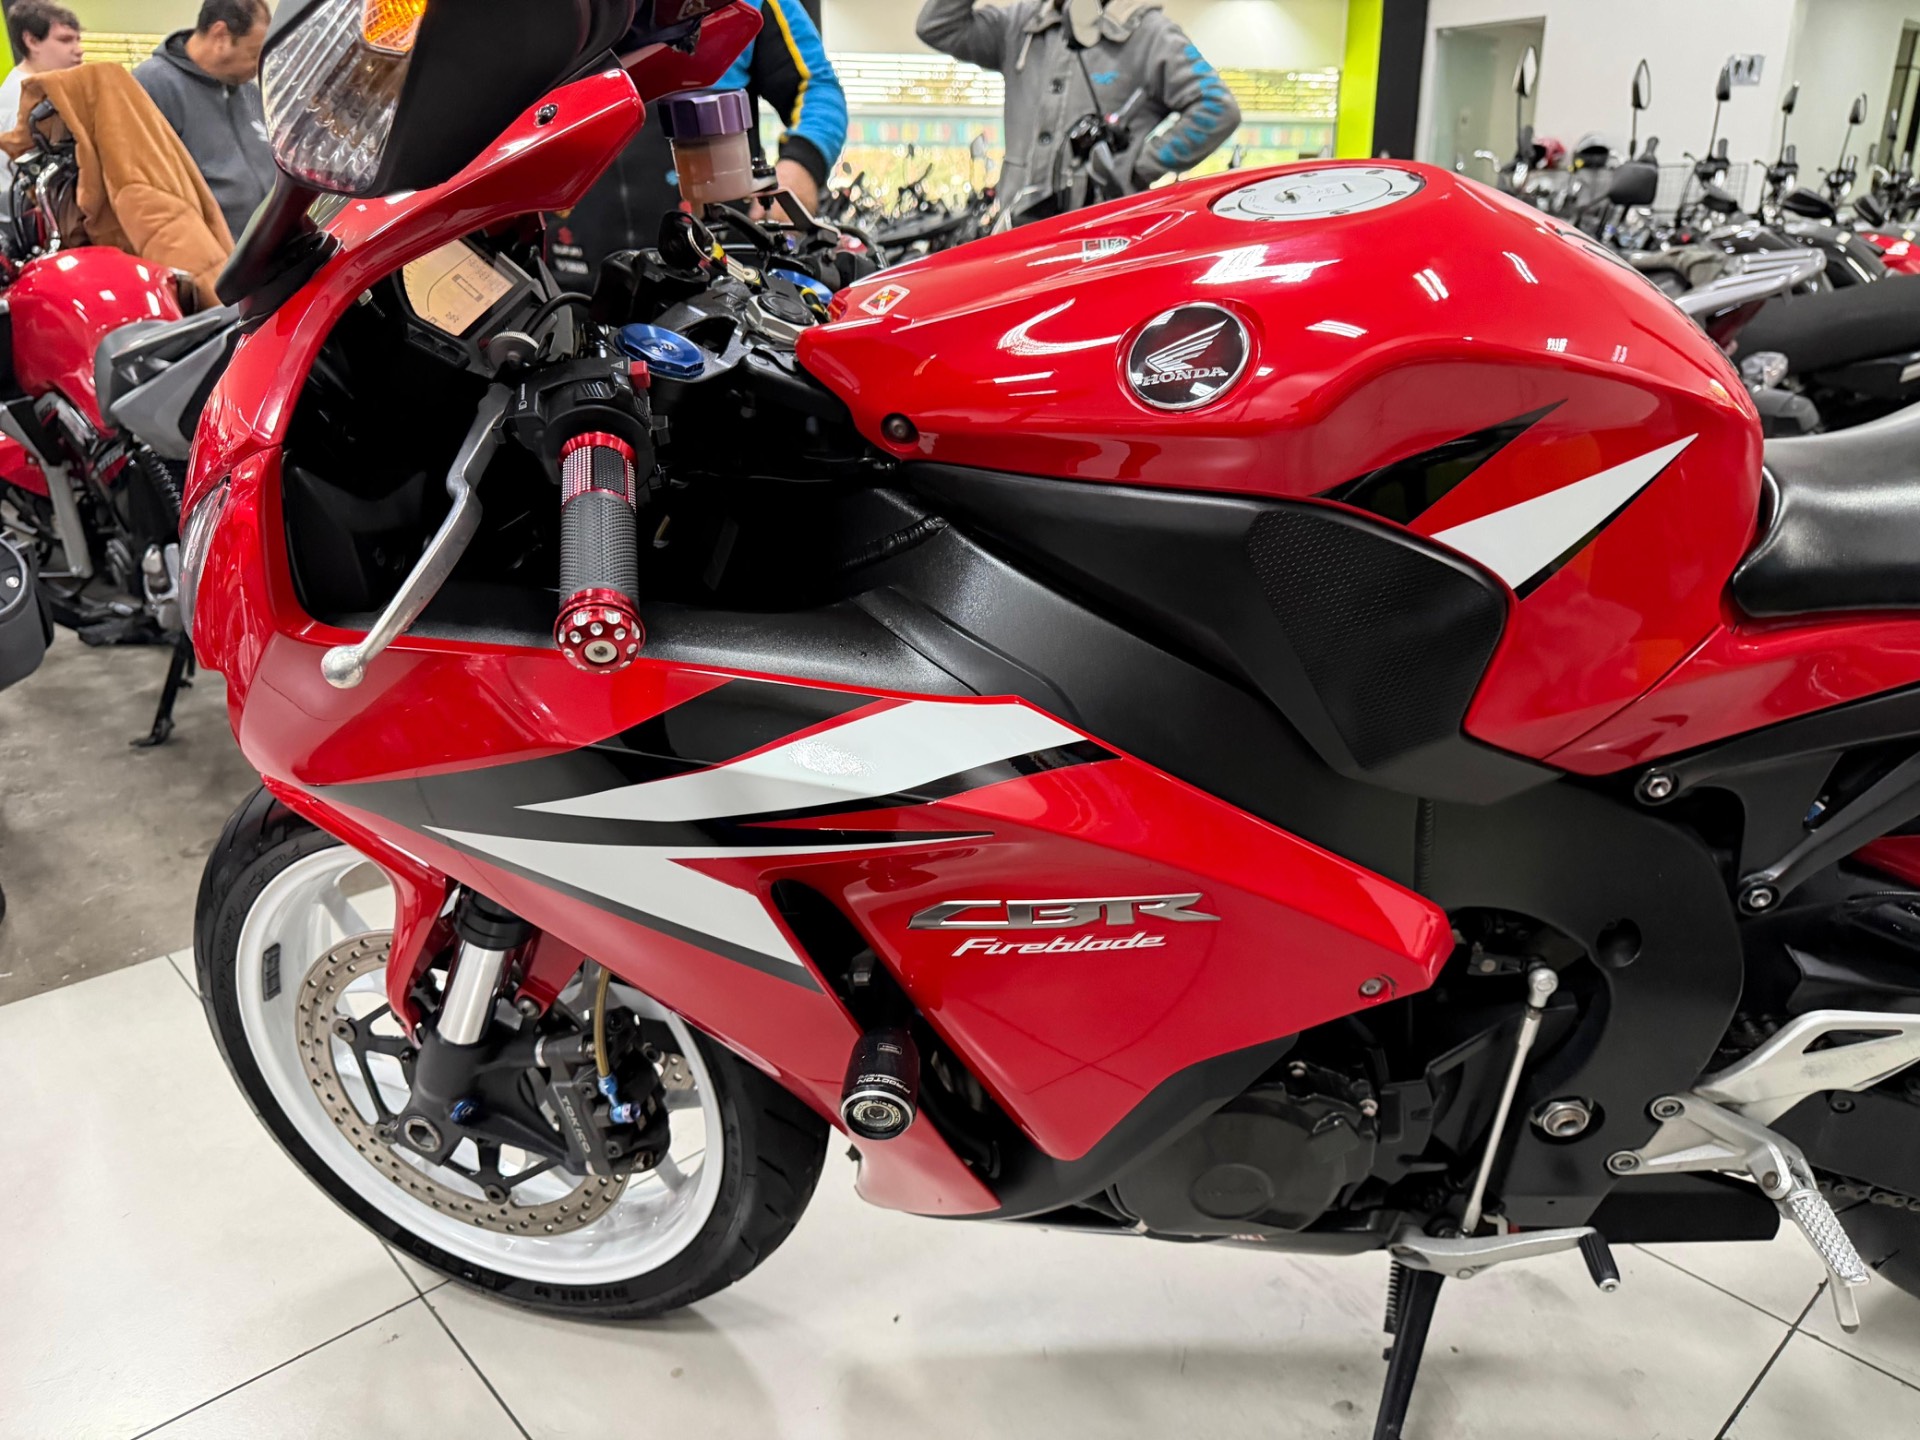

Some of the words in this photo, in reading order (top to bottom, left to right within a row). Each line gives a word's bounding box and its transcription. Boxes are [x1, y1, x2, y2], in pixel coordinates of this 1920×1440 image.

[1141, 366, 1229, 387] HONDA
[906, 892, 1222, 930] CBR
[951, 932, 1167, 957] Fireblade
[562, 1095, 592, 1154] TOKICO
